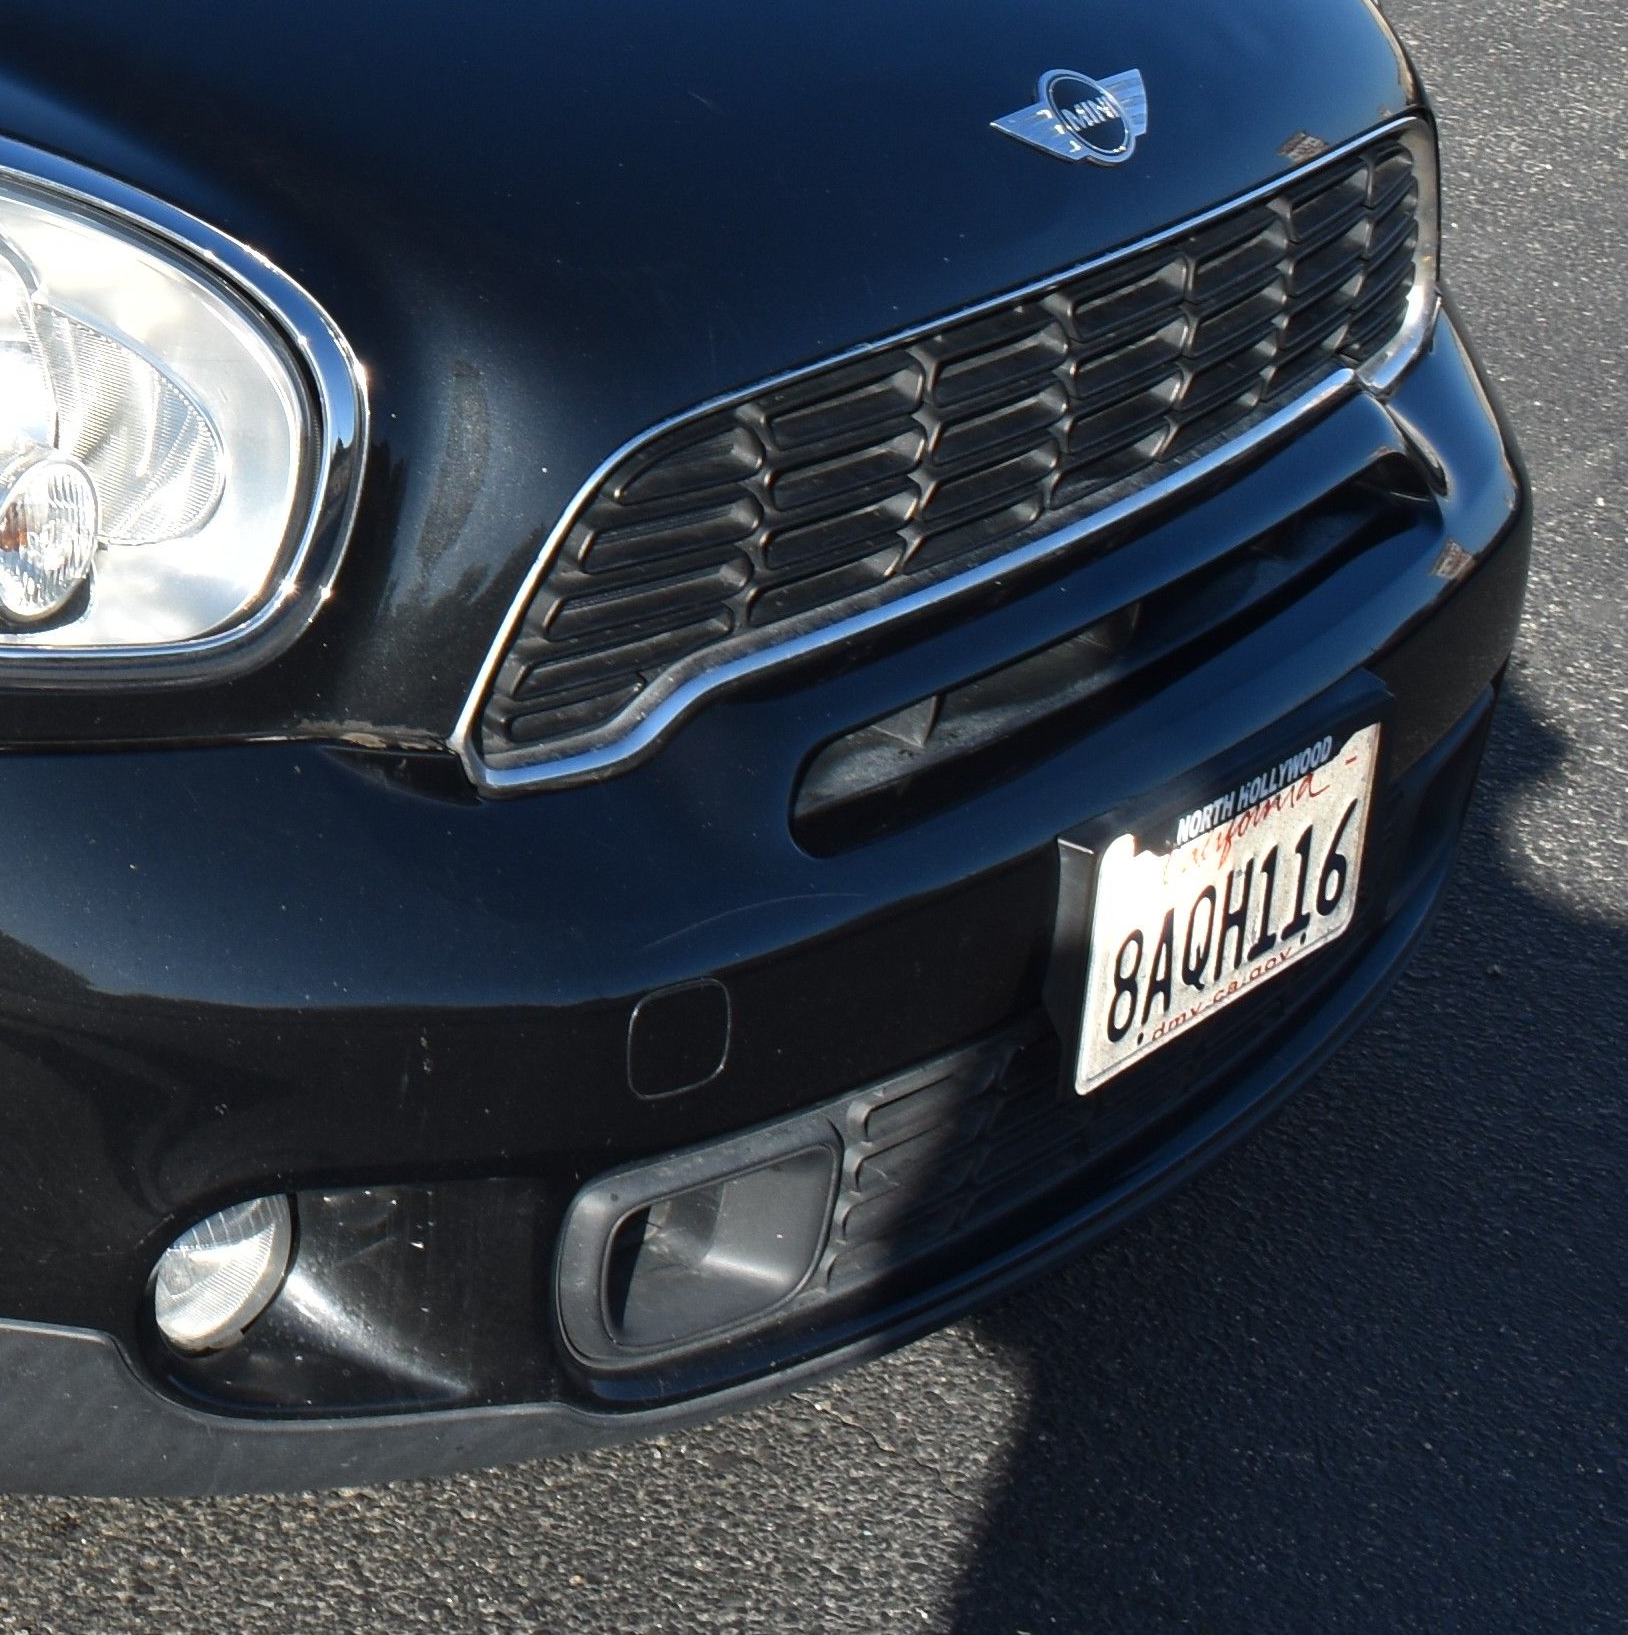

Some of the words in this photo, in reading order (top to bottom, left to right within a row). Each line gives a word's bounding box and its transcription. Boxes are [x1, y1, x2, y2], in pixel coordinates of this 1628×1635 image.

[1061, 95, 1120, 132] MINI
[1175, 791, 1236, 846] NORTH
[1236, 734, 1334, 811] HOLLYWOOD
[1106, 797, 1358, 1044] 8AQH116
